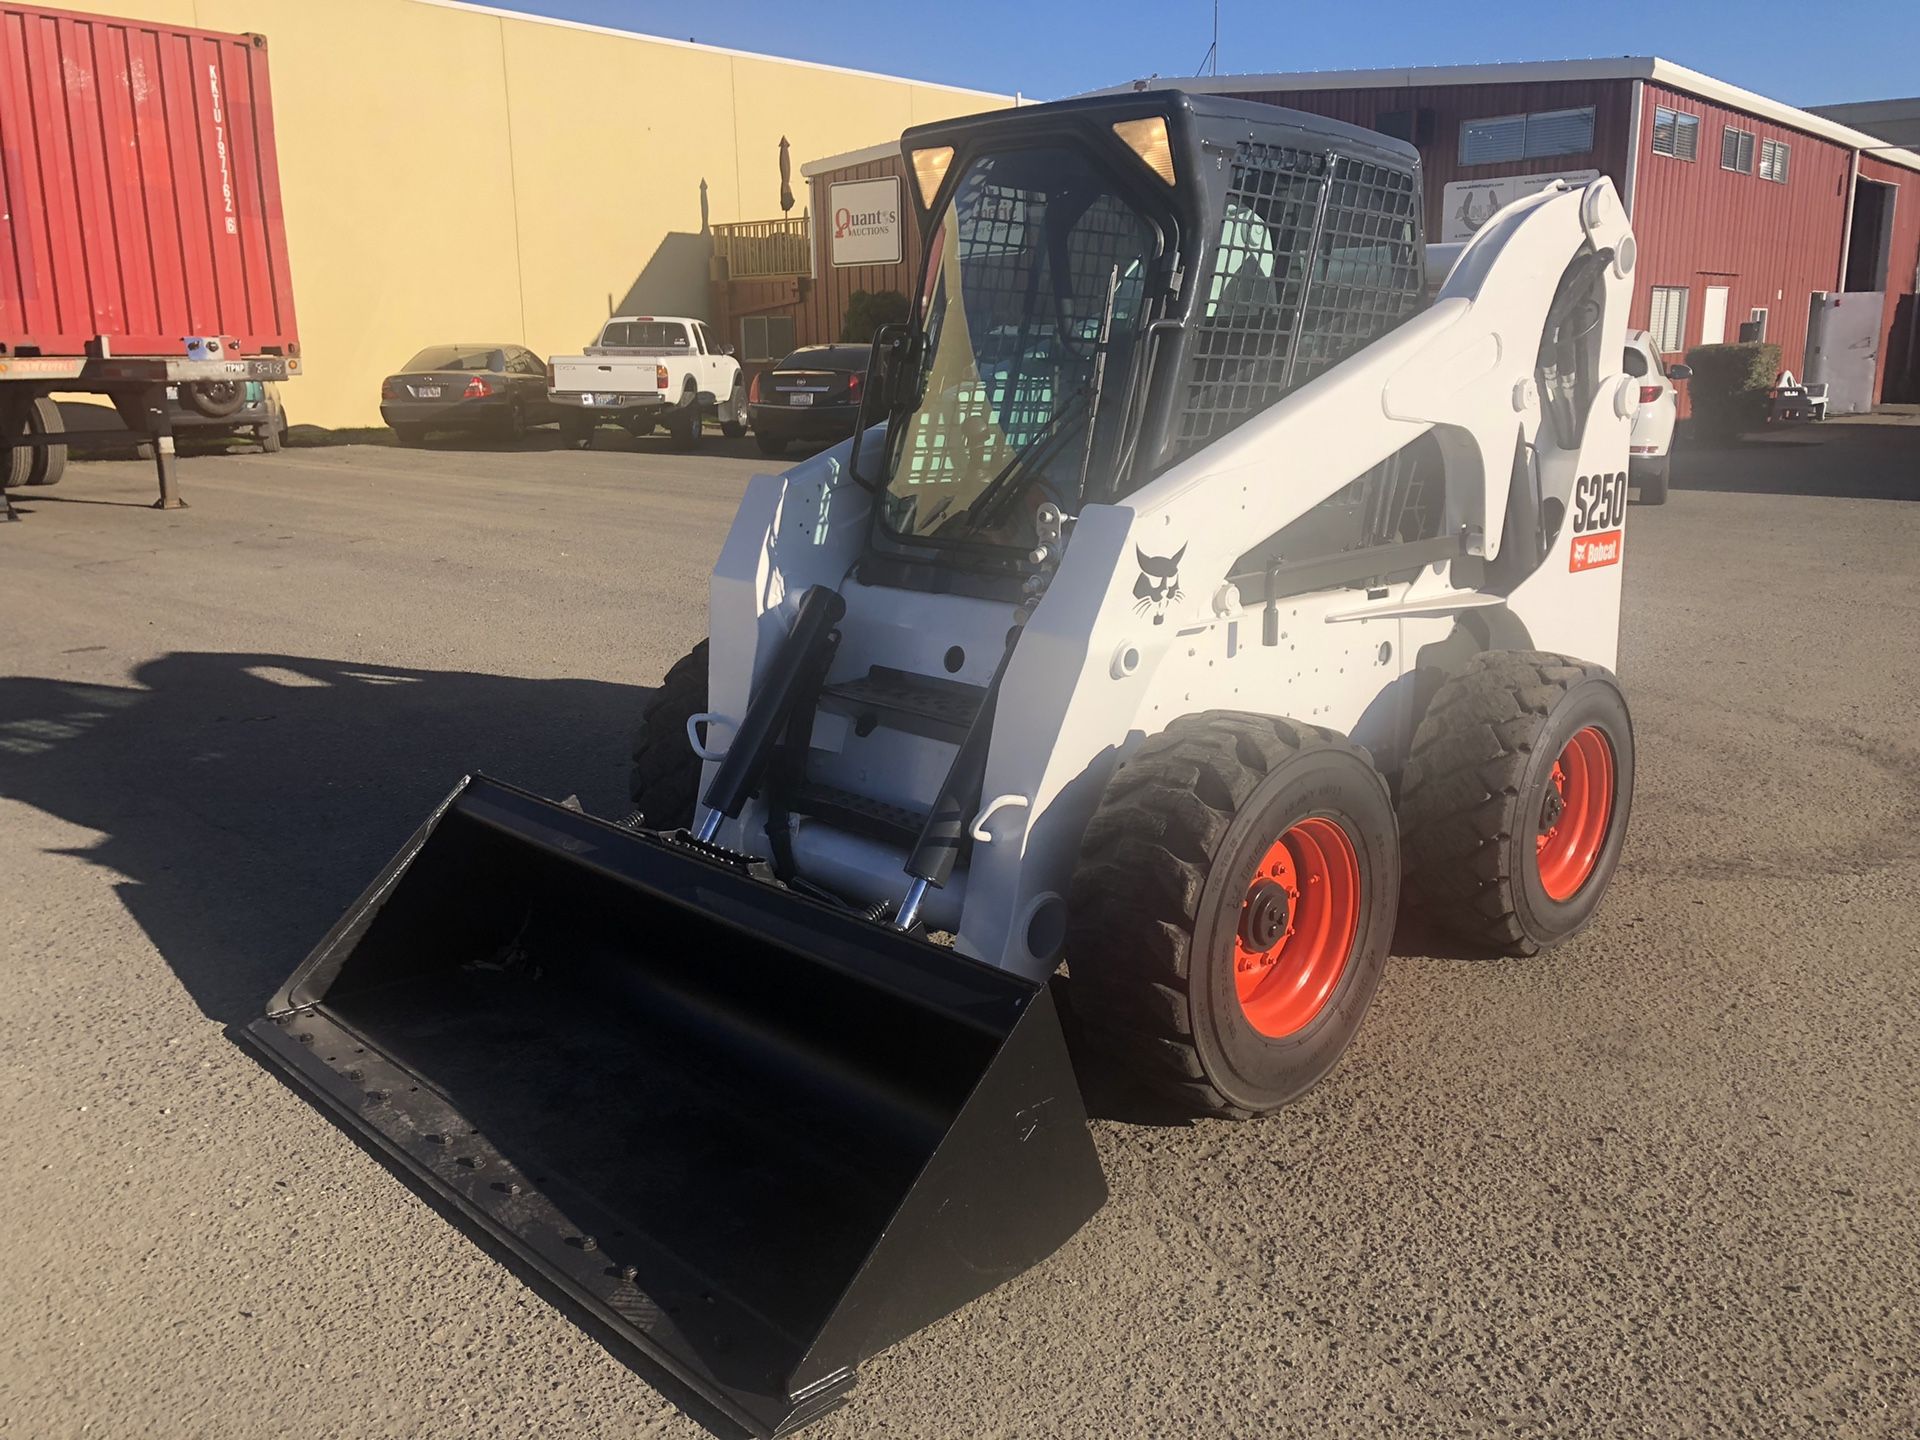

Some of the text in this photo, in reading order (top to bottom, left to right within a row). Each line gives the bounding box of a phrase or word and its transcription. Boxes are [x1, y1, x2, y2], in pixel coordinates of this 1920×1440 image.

[208, 64, 237, 234] KKTU 797762 6
[852, 225, 890, 237] AUCTIONS
[255, 362, 282, 374] 8-18
[1573, 471, 1627, 533] S250
[1587, 540, 1617, 564] Bobcat
